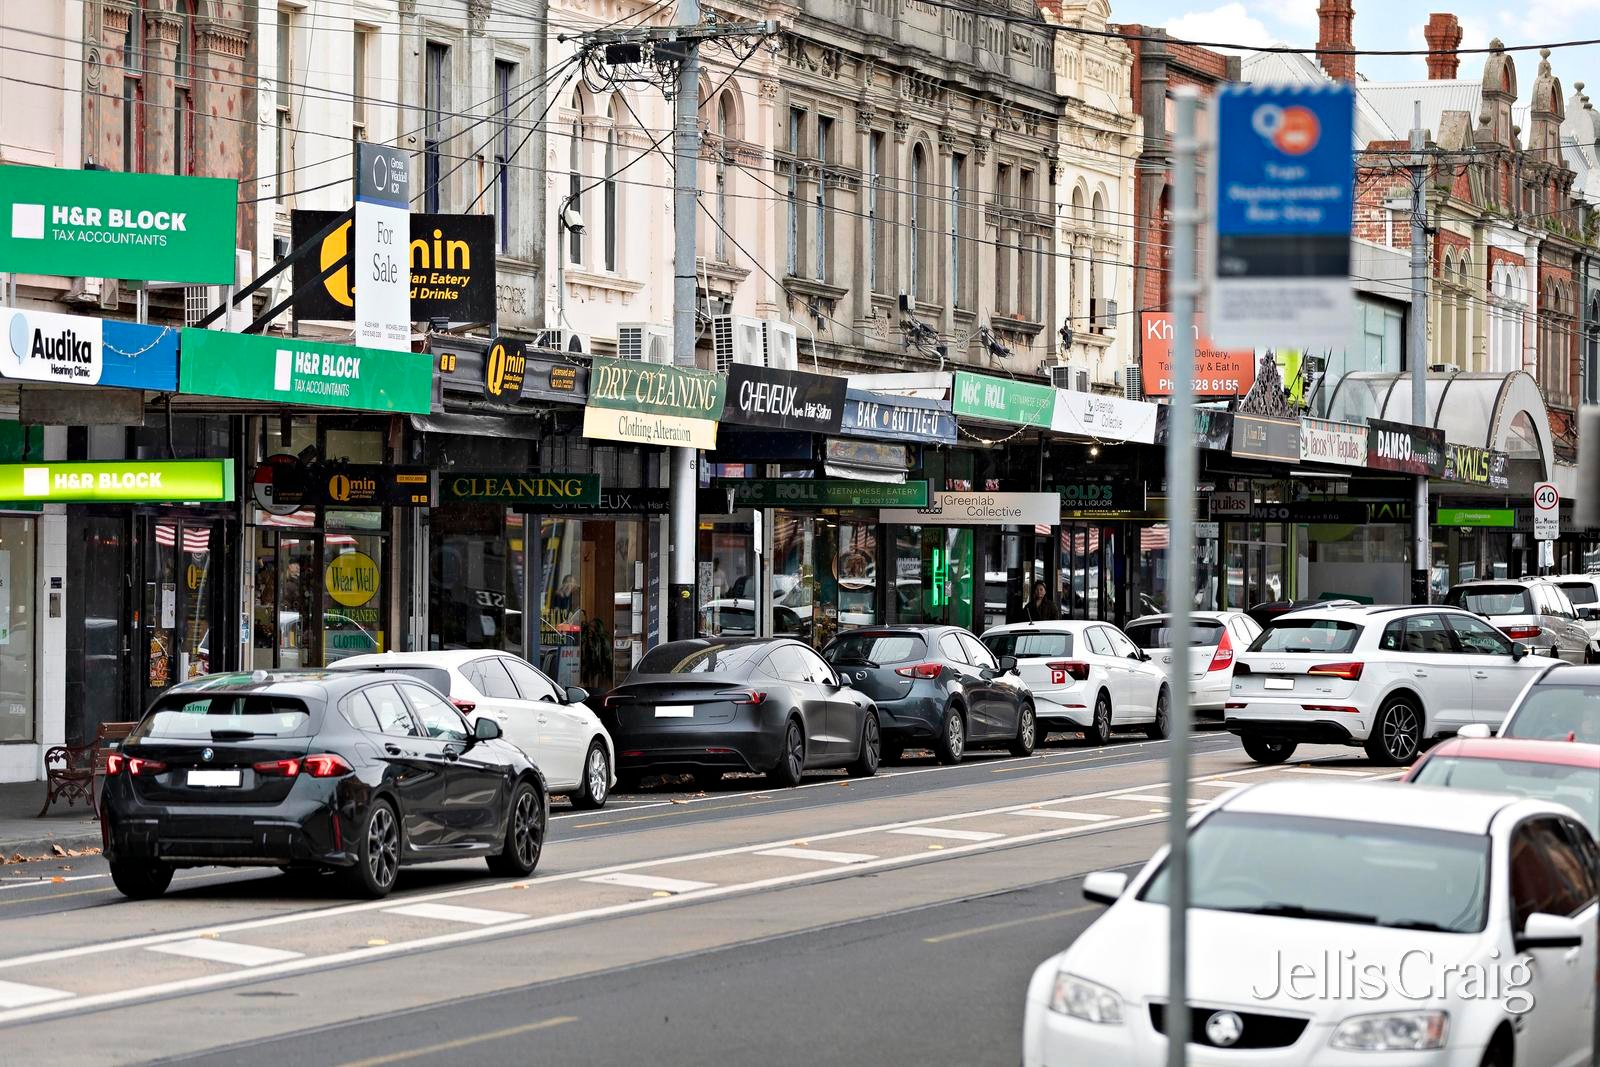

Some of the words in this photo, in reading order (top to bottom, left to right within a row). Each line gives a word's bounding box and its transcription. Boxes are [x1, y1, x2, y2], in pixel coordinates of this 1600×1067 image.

[52, 205, 103, 227] H&R
[108, 208, 188, 232] BLOCK
[52, 229, 75, 241] TAX
[77, 231, 168, 247] ACCOUNTANTS
[376, 221, 394, 245] For
[372, 253, 398, 284] Sale
[430, 273, 470, 287] Eatery
[414, 287, 459, 300] Drinks
[1147, 319, 1199, 340] Khn
[31, 327, 92, 363] Audika
[50, 363, 73, 379] Hearing
[73, 366, 91, 378] Clinic
[294, 351, 320, 375] H&R
[321, 354, 361, 380] BLOCK
[1215, 362, 1229, 371] Eat
[1231, 363, 1240, 371] In
[294, 379, 306, 392] TAX
[306, 380, 350, 397] ACCOUNTANTS
[593, 366, 635, 402] DRY
[635, 370, 717, 411] CLEANING
[1211, 378, 1240, 392] 6155
[739, 380, 798, 415] CHEVEUX
[804, 402, 817, 418] Hair
[816, 403, 832, 420] Salon
[983, 384, 1006, 410] ROLL
[617, 415, 651, 442] Clothing
[652, 419, 692, 442] Alteration
[856, 402, 878, 430] BAR
[891, 407, 938, 435] BOTTLE-O
[1310, 431, 1327, 456] Tacos
[1336, 434, 1360, 463] Tequilas
[1377, 430, 1412, 462] DAMSO
[1455, 448, 1490, 482] NAILS
[55, 473, 96, 489] H&R
[100, 471, 163, 489] BLOCK
[328, 474, 377, 502] Qmin
[452, 478, 584, 498] CLEANING
[775, 484, 819, 500] ROLL
[826, 487, 883, 496] VIETNAMESE
[886, 486, 919, 496] EATERY
[943, 494, 995, 507] Greenlab
[1538, 491, 1556, 503] 40
[966, 505, 1022, 518] Collective
[1210, 495, 1247, 512] quilas
[1254, 508, 1290, 518] MSO
[331, 566, 354, 593] Wear
[355, 566, 375, 593] Well
[343, 608, 379, 623] CLEANERS
[1053, 671, 1063, 684] P
